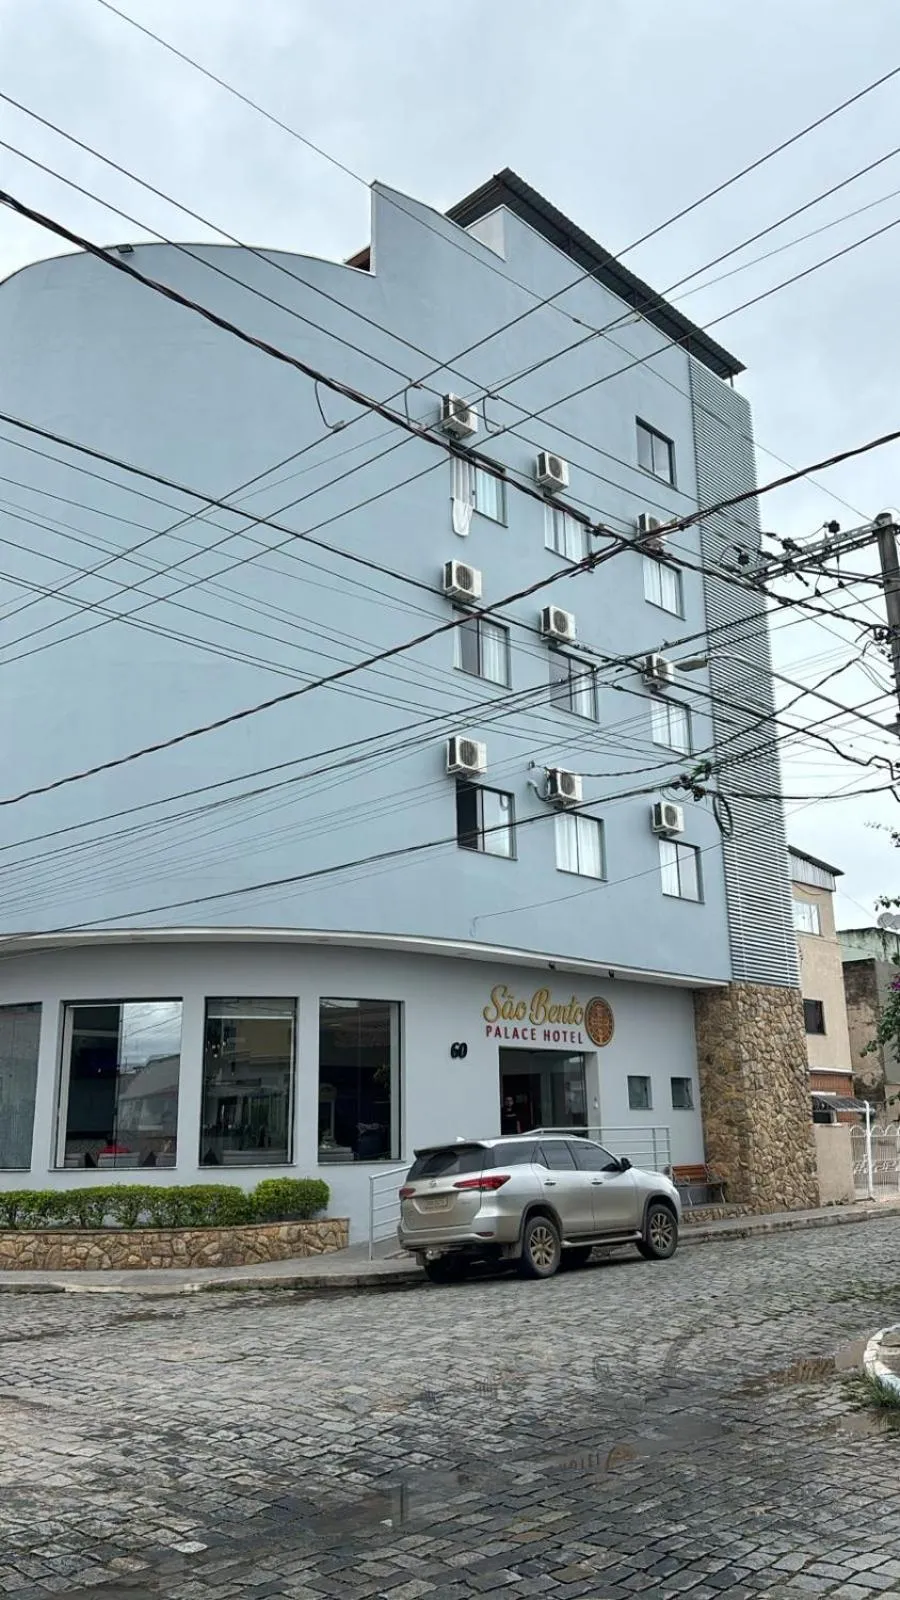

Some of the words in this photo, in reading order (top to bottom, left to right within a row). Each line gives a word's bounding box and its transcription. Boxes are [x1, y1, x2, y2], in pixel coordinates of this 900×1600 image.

[483, 984, 527, 1023] São
[529, 988, 584, 1025] Bento
[486, 1025, 536, 1041] PALACE
[543, 1029, 584, 1044] HOTEL
[450, 1041, 468, 1058] 60
